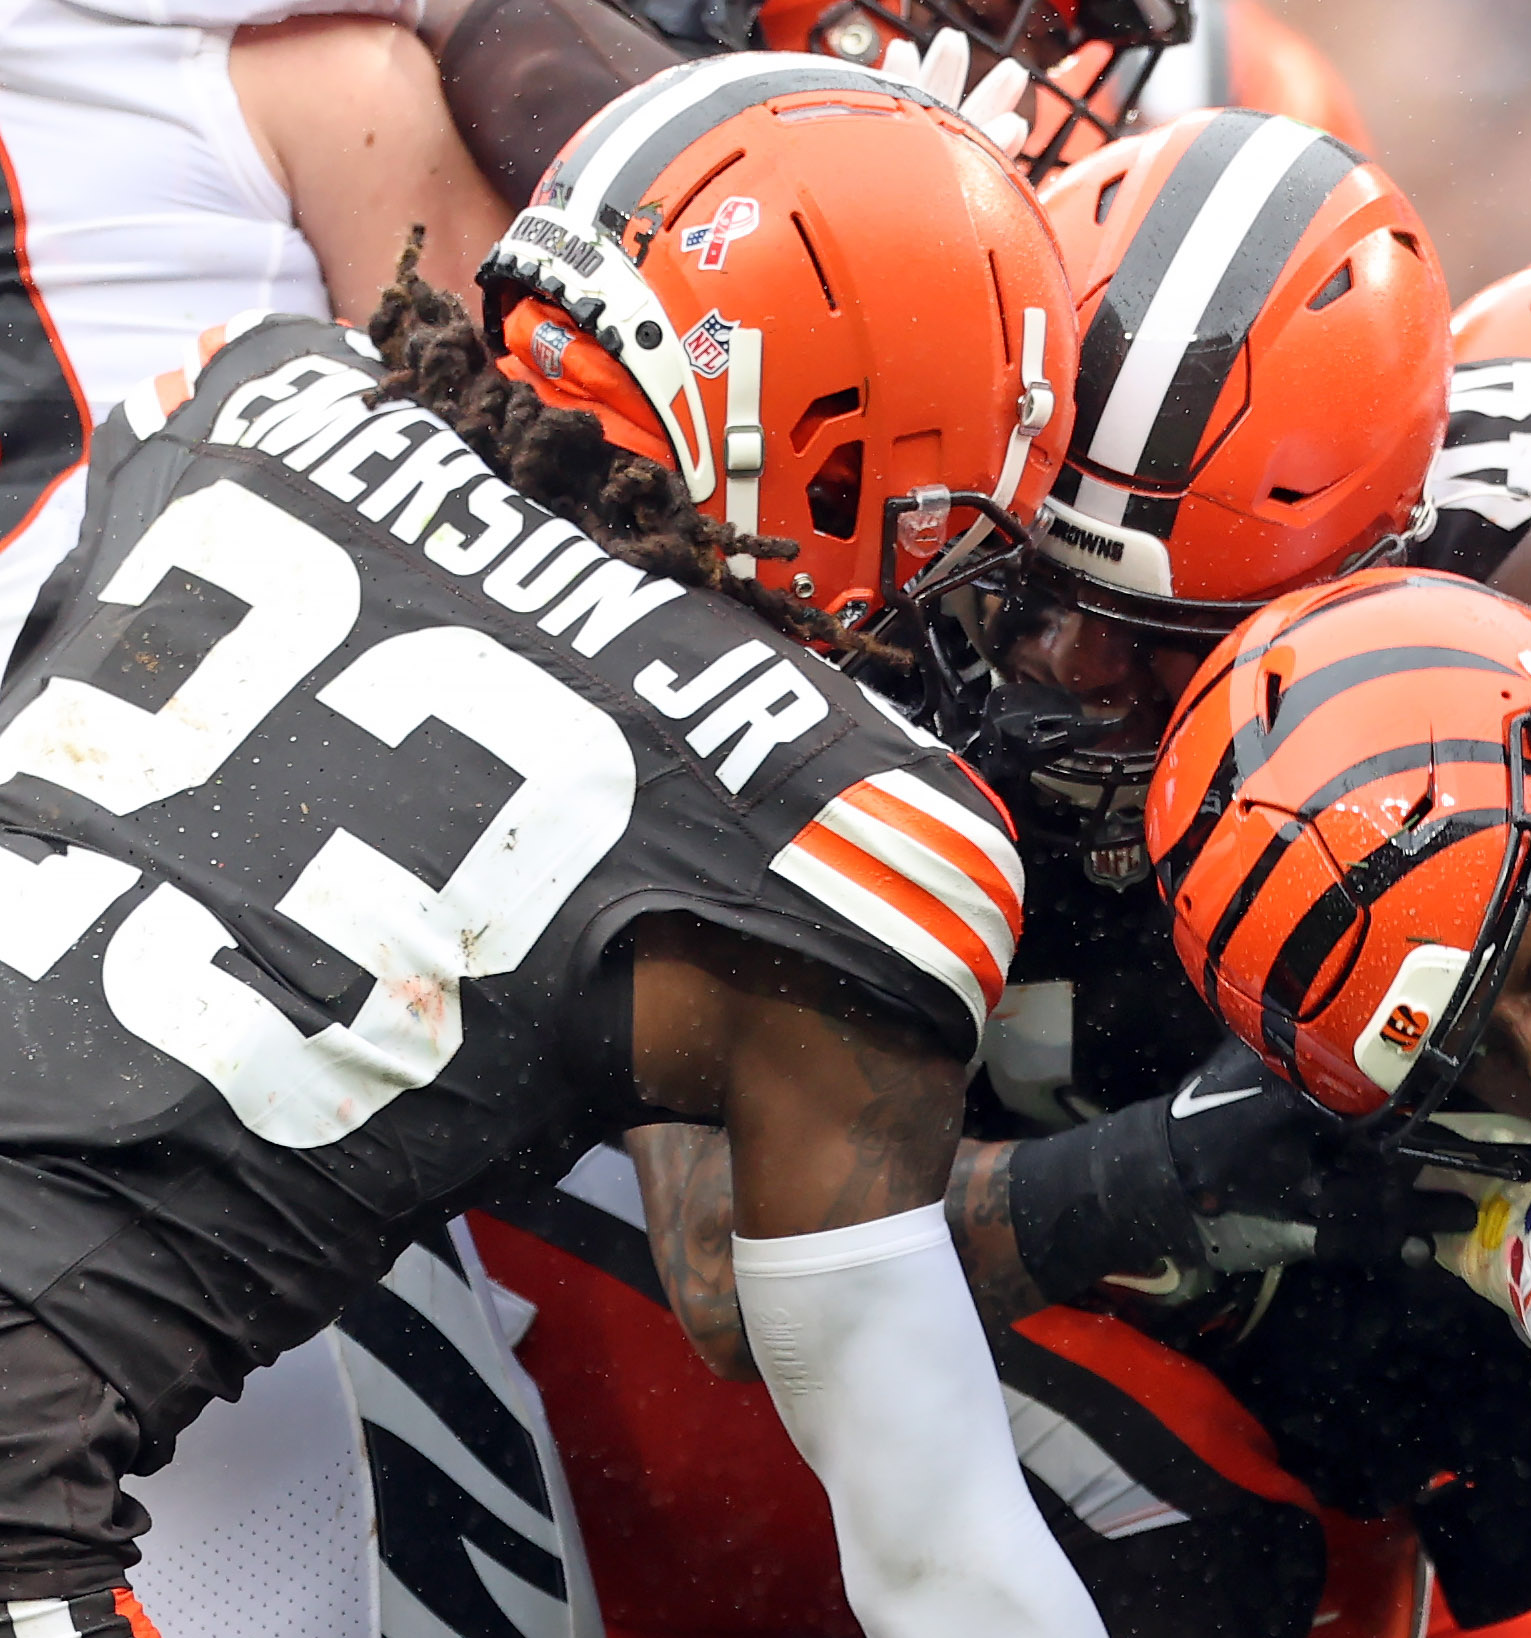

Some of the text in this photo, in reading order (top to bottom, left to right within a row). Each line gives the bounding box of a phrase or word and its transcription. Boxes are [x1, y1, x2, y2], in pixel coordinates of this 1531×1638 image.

[511, 215, 604, 278] CLEVELAND
[687, 332, 723, 370] NFL
[208, 354, 829, 795] EMERSON JR
[0, 478, 636, 1148] 23
